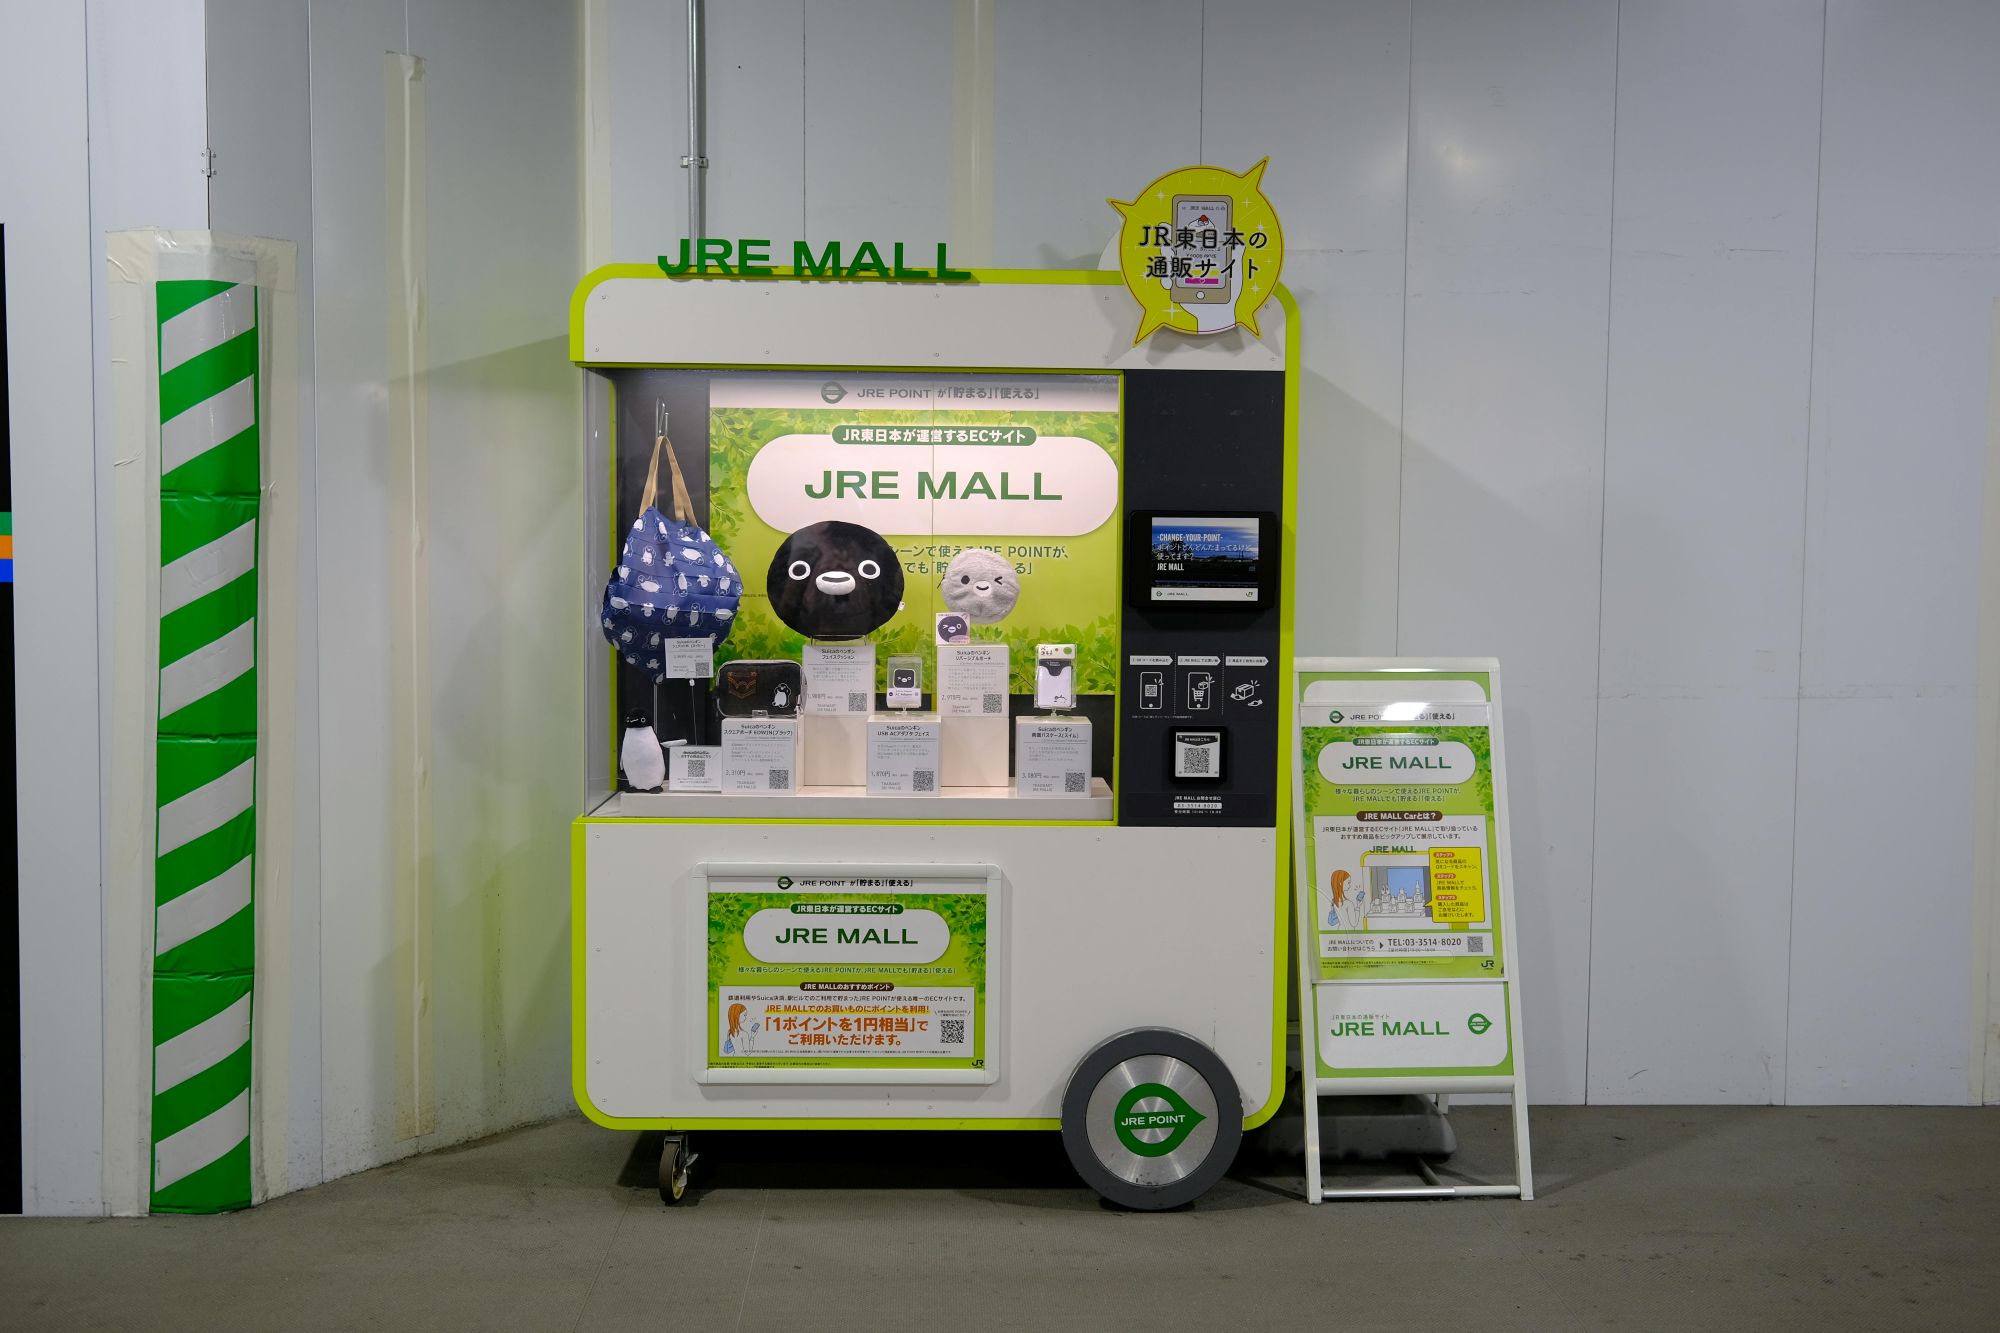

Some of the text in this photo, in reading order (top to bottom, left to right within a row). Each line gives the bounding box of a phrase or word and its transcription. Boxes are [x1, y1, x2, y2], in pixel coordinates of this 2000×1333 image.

[1138, 226, 1268, 250] JR東日本の
[657, 238, 971, 280] JRE MALL
[1146, 256, 1259, 279] 通販サイト
[858, 388, 884, 398] JRE
[890, 389, 932, 398] POINT
[842, 428, 1026, 443] JR東日本が運営するECサイト
[804, 470, 1062, 500] JRE MALL
[1342, 757, 1451, 769] JRE MALL
[796, 905, 898, 913] JR東日本が運営するECサイト
[776, 928, 918, 944] JRE MALL
[1388, 938, 1462, 946] TEL:03-3514-8020
[765, 1016, 928, 1032] 「1ポイントを1円相当」で
[1331, 1021, 1450, 1036] JRE MALL
[788, 1034, 901, 1046] ご利用いただけます。
[1121, 1114, 1186, 1126] JRE POINT
